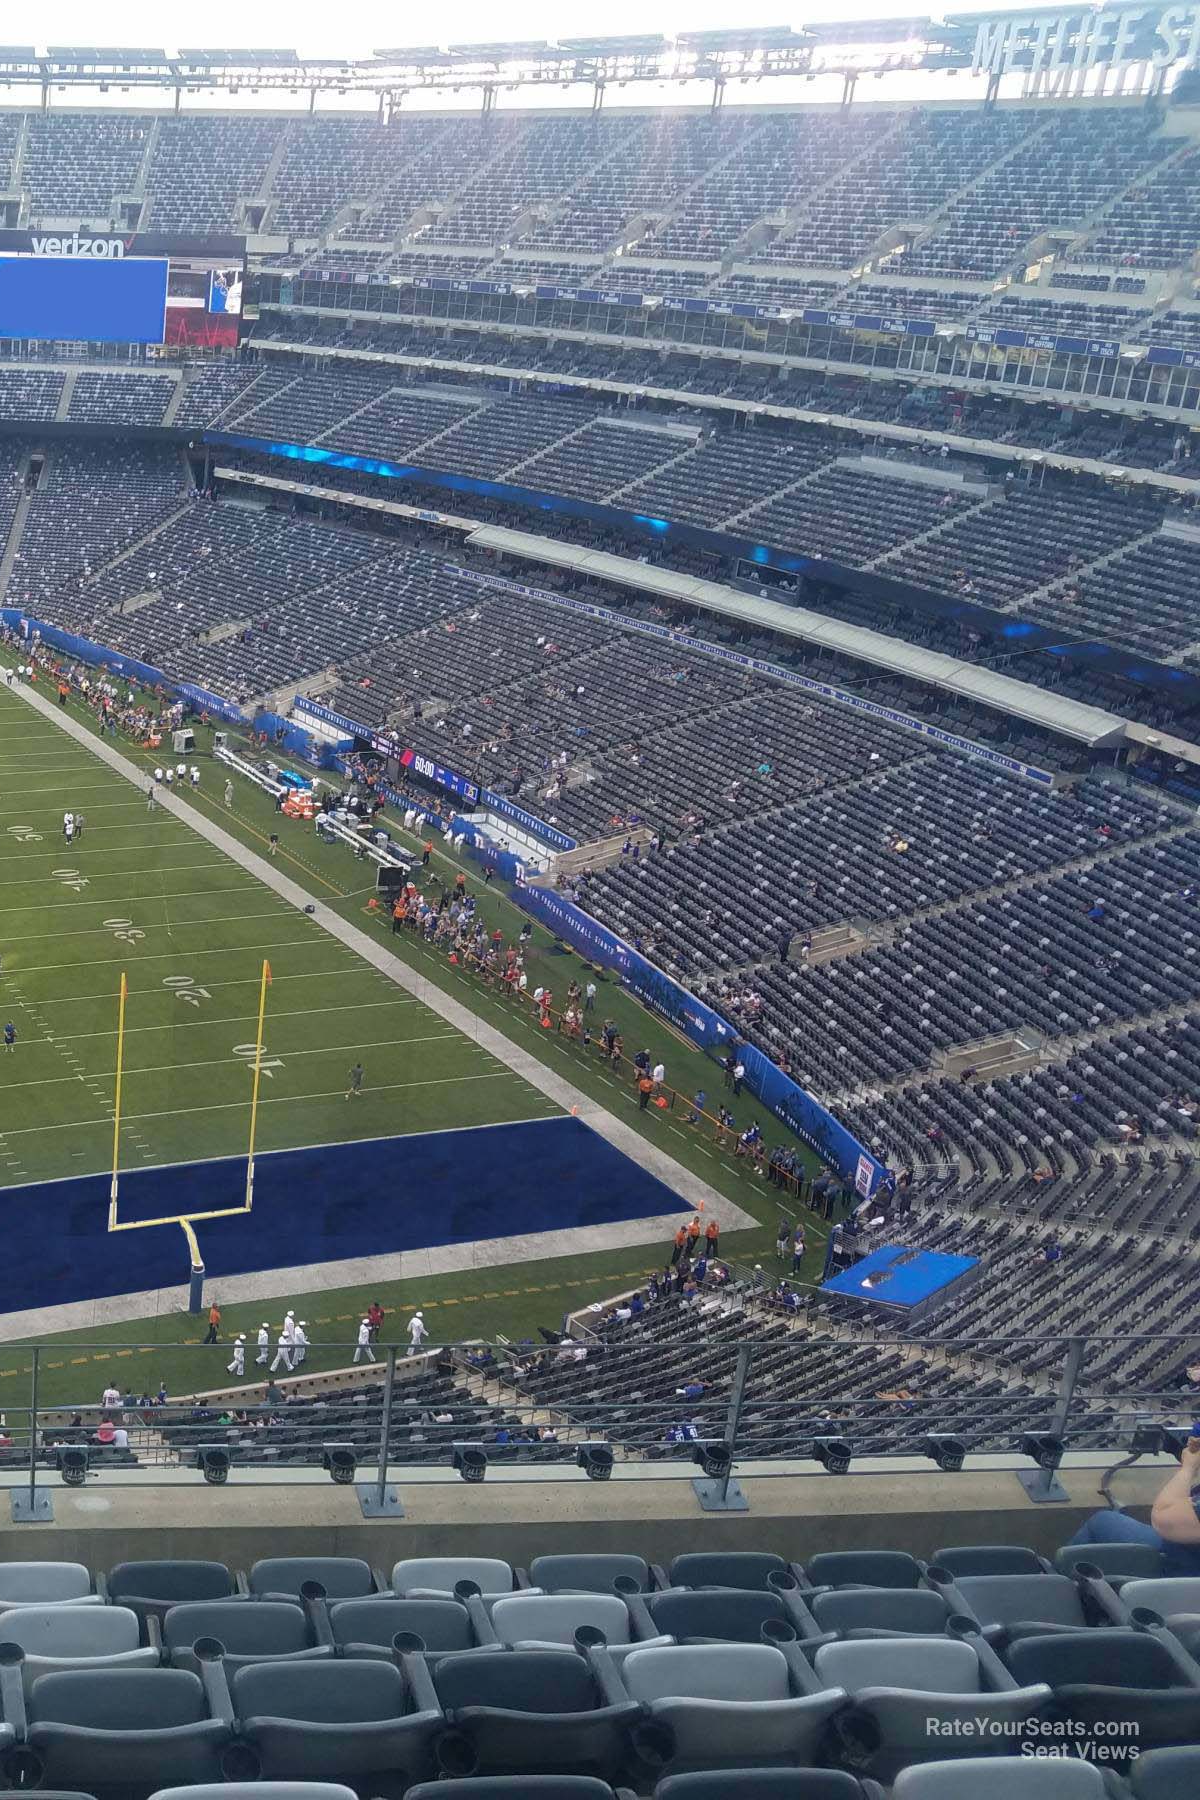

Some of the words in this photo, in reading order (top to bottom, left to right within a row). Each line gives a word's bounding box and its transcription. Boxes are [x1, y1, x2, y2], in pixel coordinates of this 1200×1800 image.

[31, 233, 126, 258] verizon
[414, 755, 435, 778] 60:00
[7, 825, 44, 841] 50
[51, 869, 90, 888] 40
[102, 918, 146, 940] 30
[162, 976, 212, 1002] 20
[232, 1043, 286, 1069] 10
